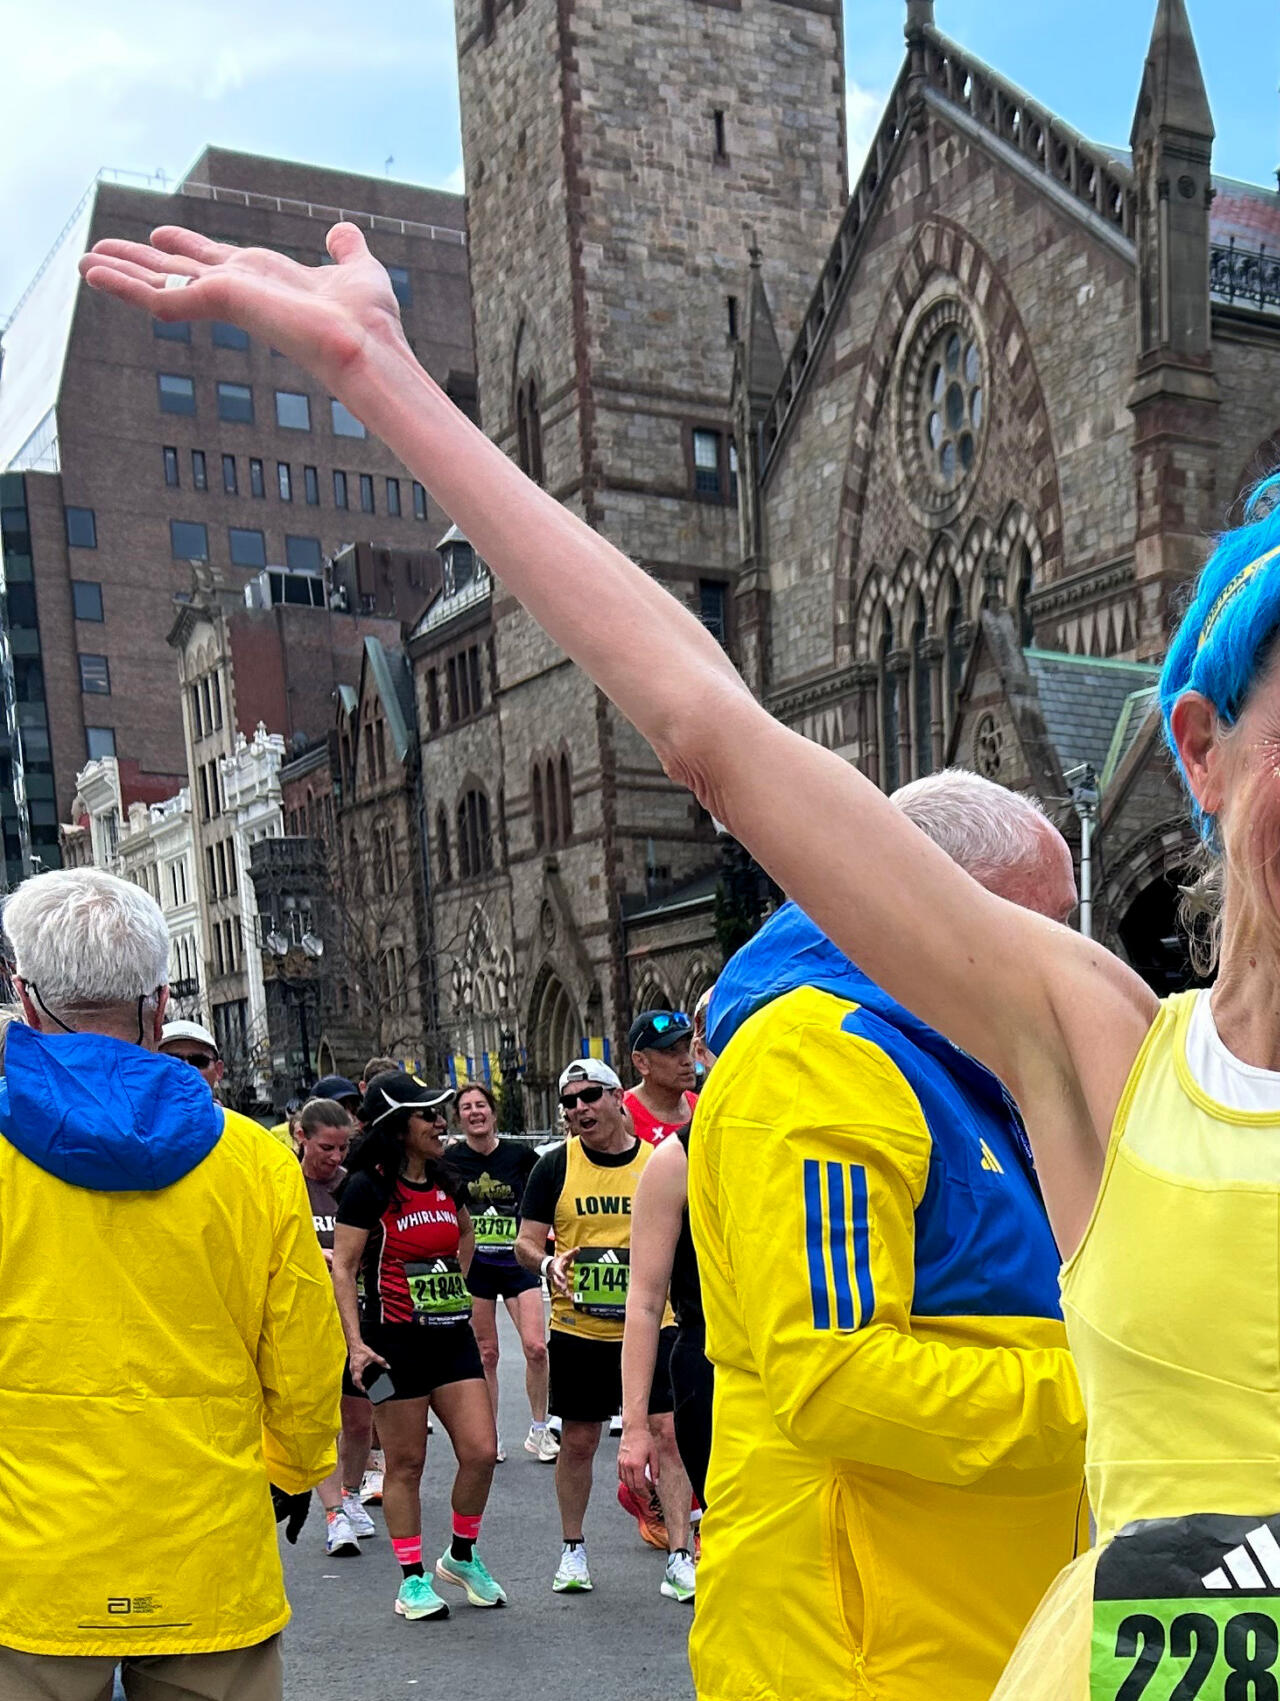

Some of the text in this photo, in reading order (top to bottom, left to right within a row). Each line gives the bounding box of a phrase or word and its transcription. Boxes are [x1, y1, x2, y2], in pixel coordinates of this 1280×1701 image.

[575, 1195, 631, 1216] LOWE
[397, 1209, 459, 1232] WHIRLAWA
[472, 1218, 513, 1236] 23797
[414, 1276, 466, 1303] 21843
[578, 1266, 630, 1292] 2144
